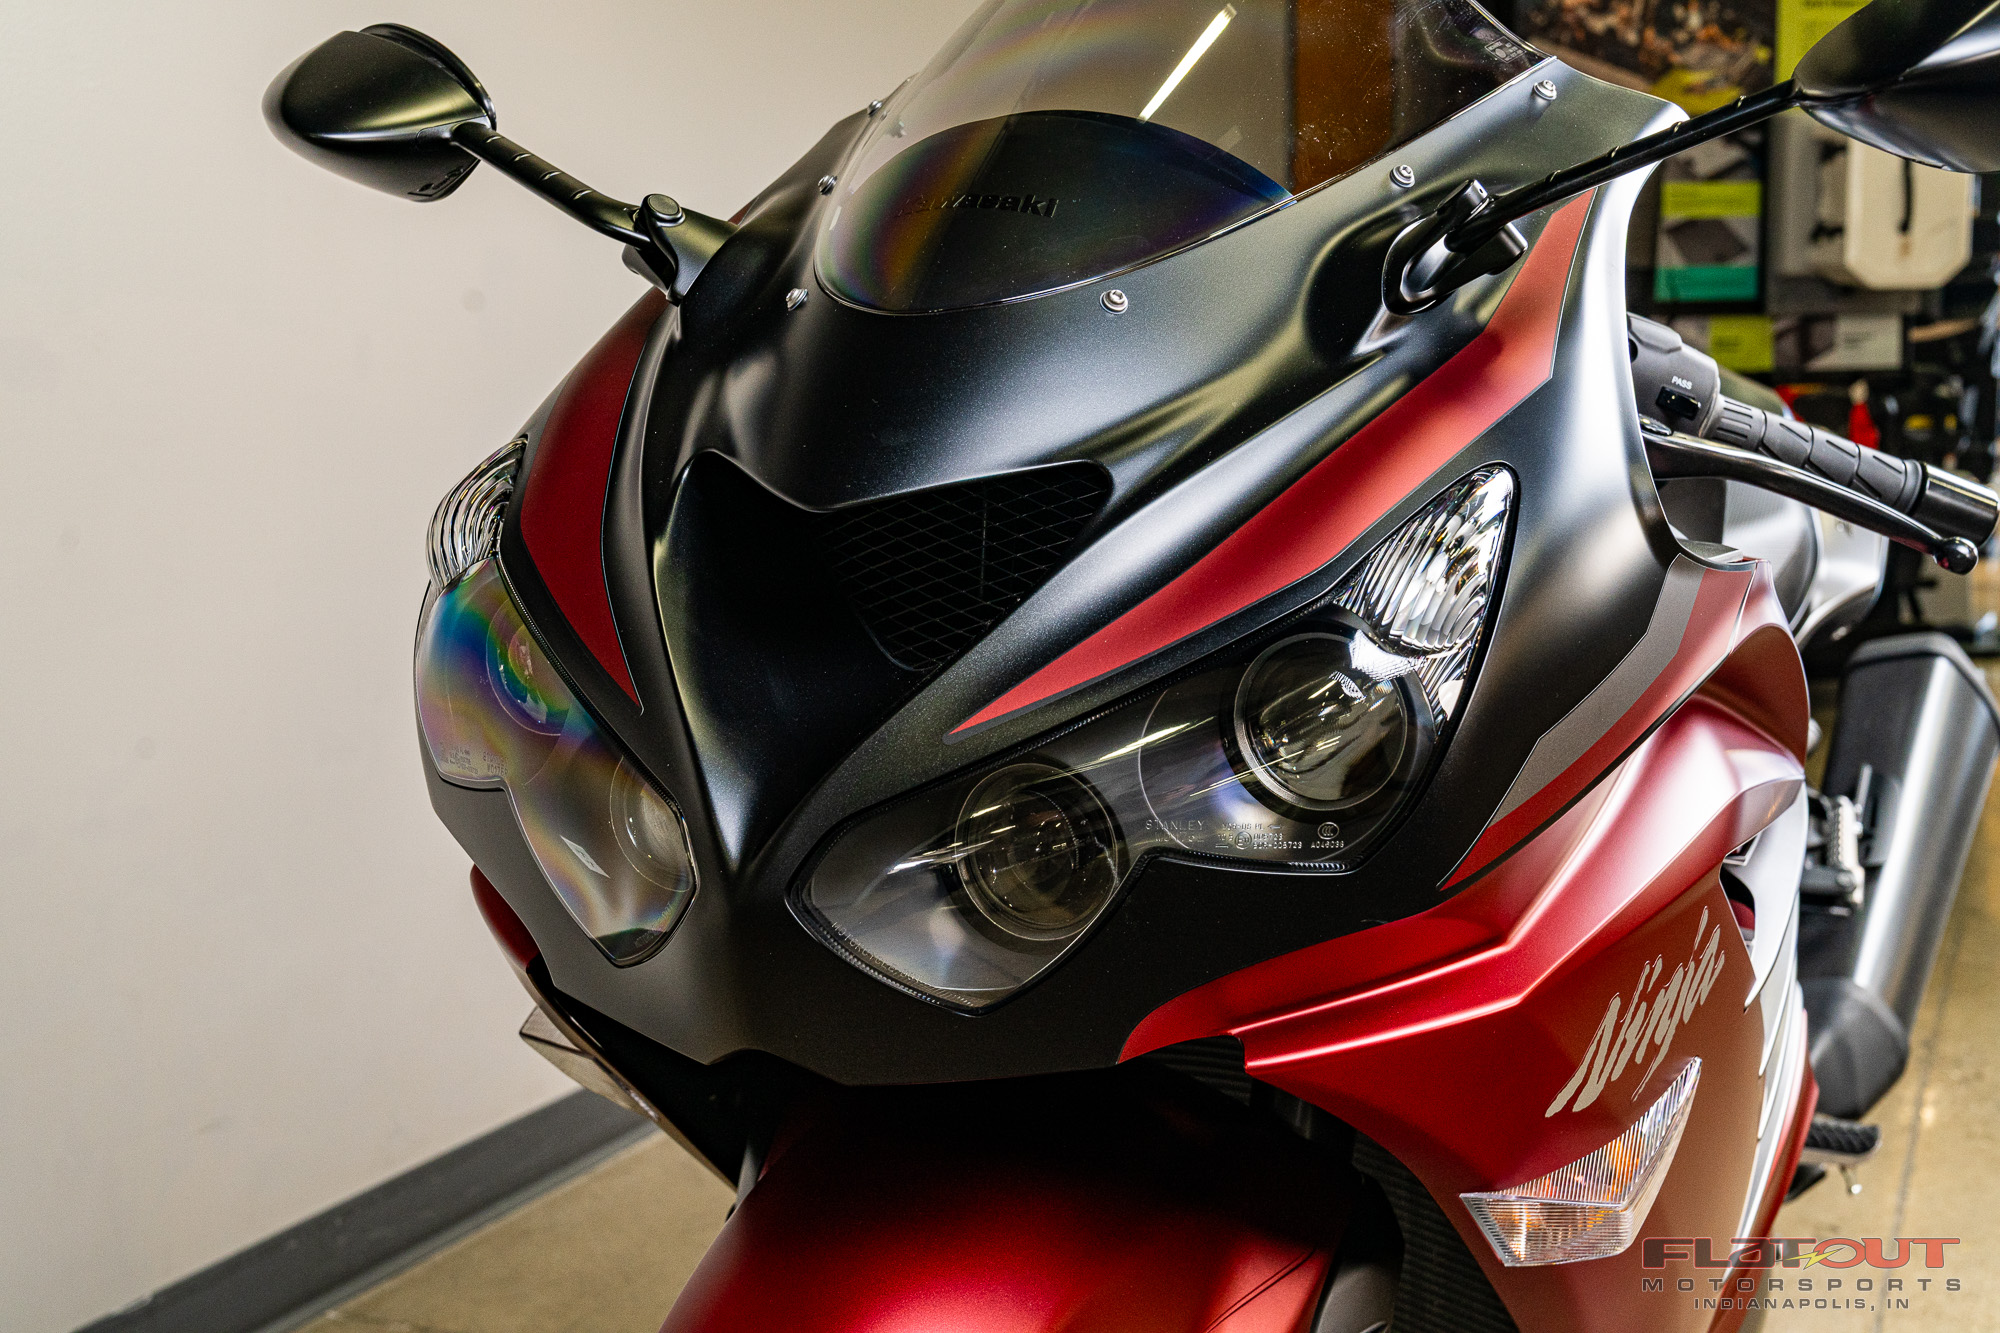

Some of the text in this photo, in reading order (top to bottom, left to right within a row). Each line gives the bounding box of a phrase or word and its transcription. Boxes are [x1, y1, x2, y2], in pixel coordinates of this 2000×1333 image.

[896, 193, 1060, 219] awasaki
[1671, 375, 1693, 390] PASS
[1145, 819, 1205, 831] STANLEY
[1544, 905, 1726, 1118] Ninja
